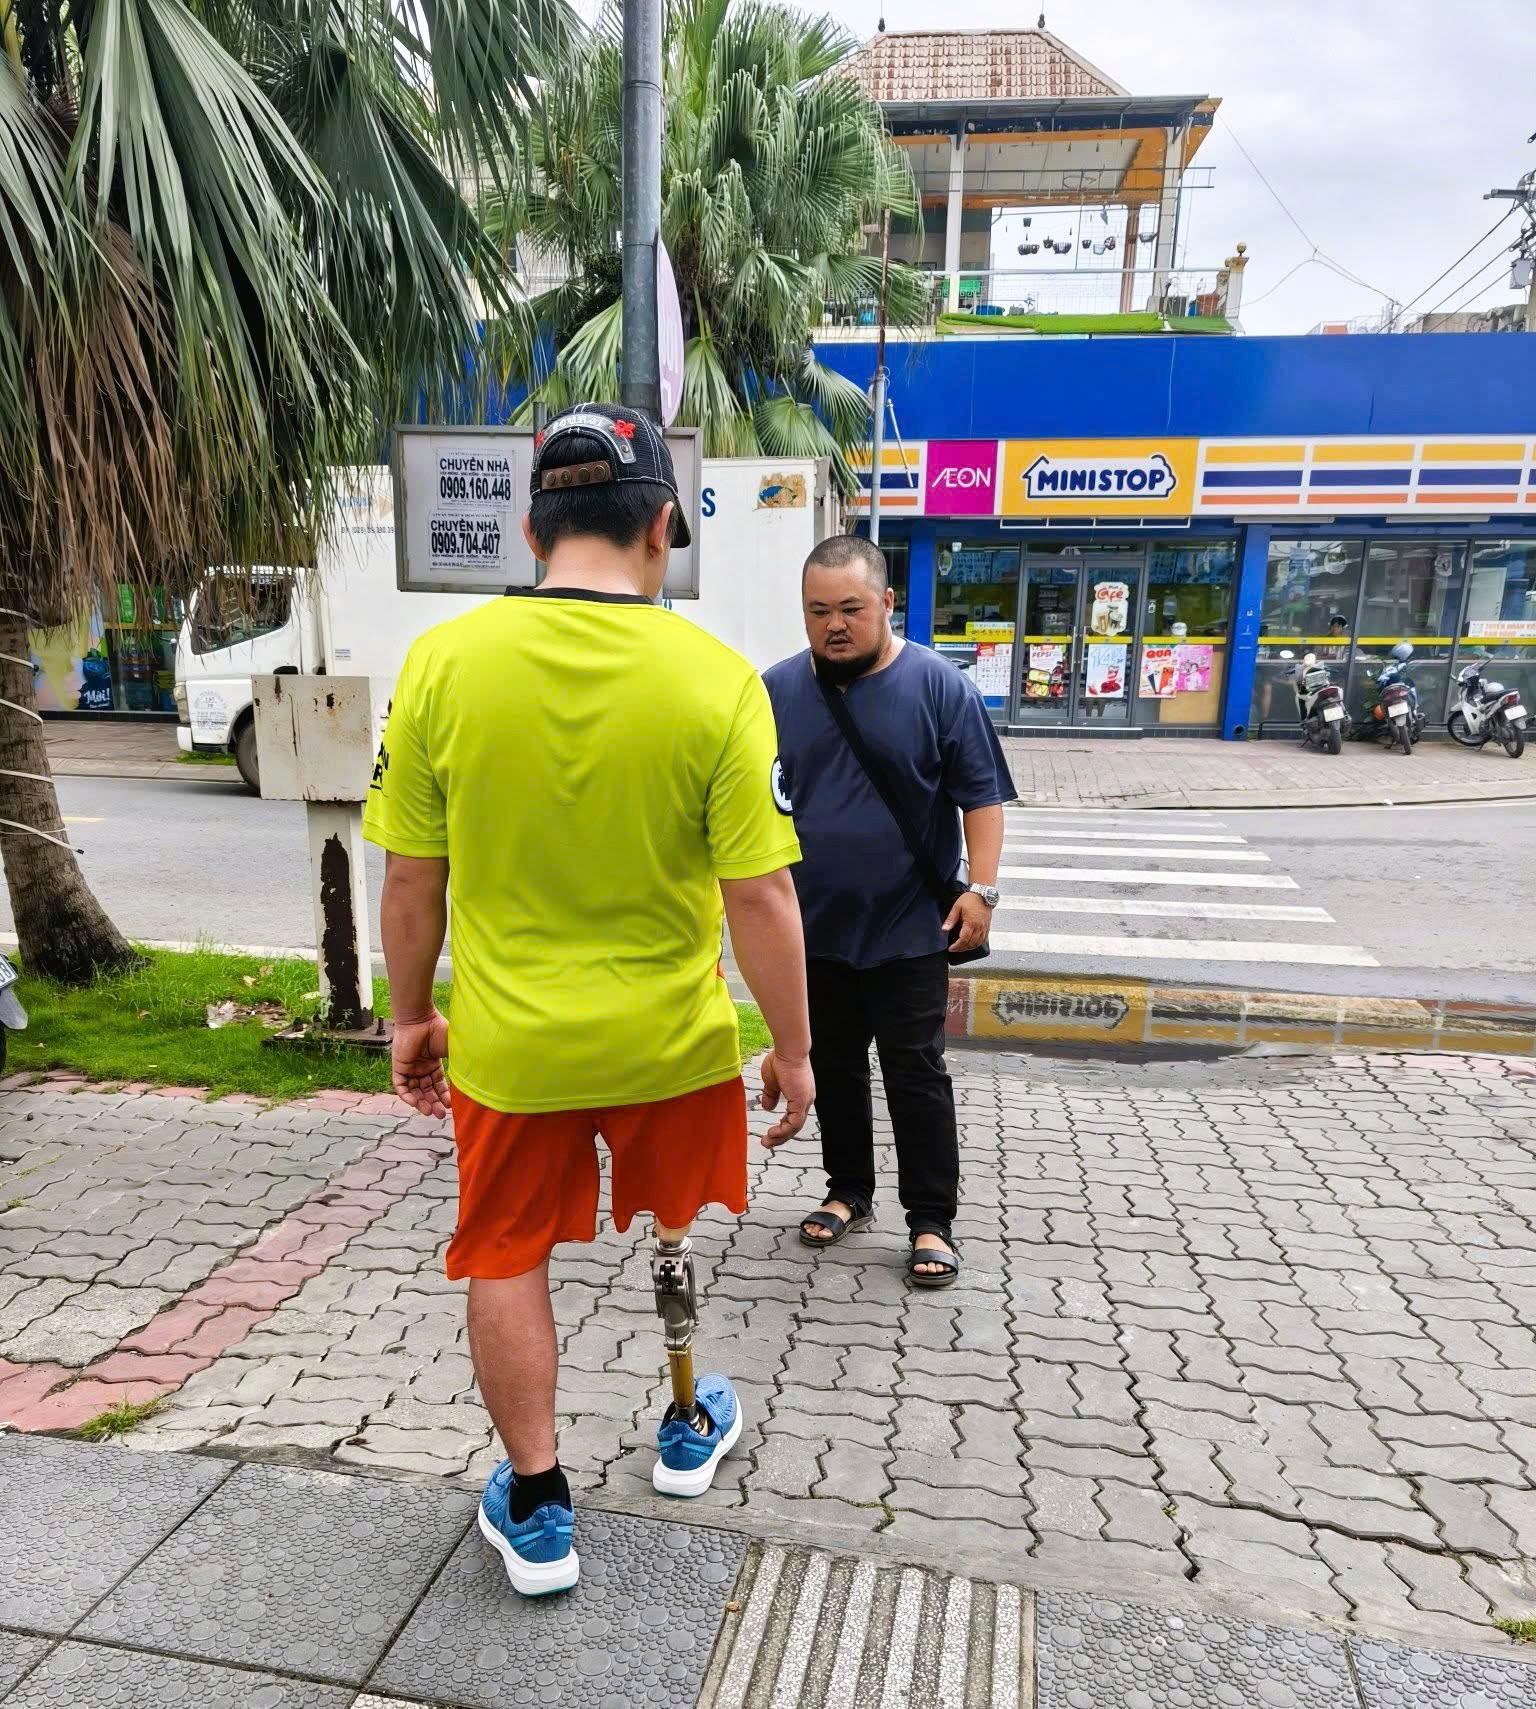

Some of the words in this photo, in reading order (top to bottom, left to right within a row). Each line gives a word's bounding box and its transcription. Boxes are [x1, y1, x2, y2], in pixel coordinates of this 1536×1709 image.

[487, 458, 510, 472] NHÀ
[440, 476, 511, 501] 0909.160.448
[1037, 467, 1166, 492] MINISTOP
[476, 518, 500, 532] NHÀ
[431, 532, 501, 555] 0909.704.407
